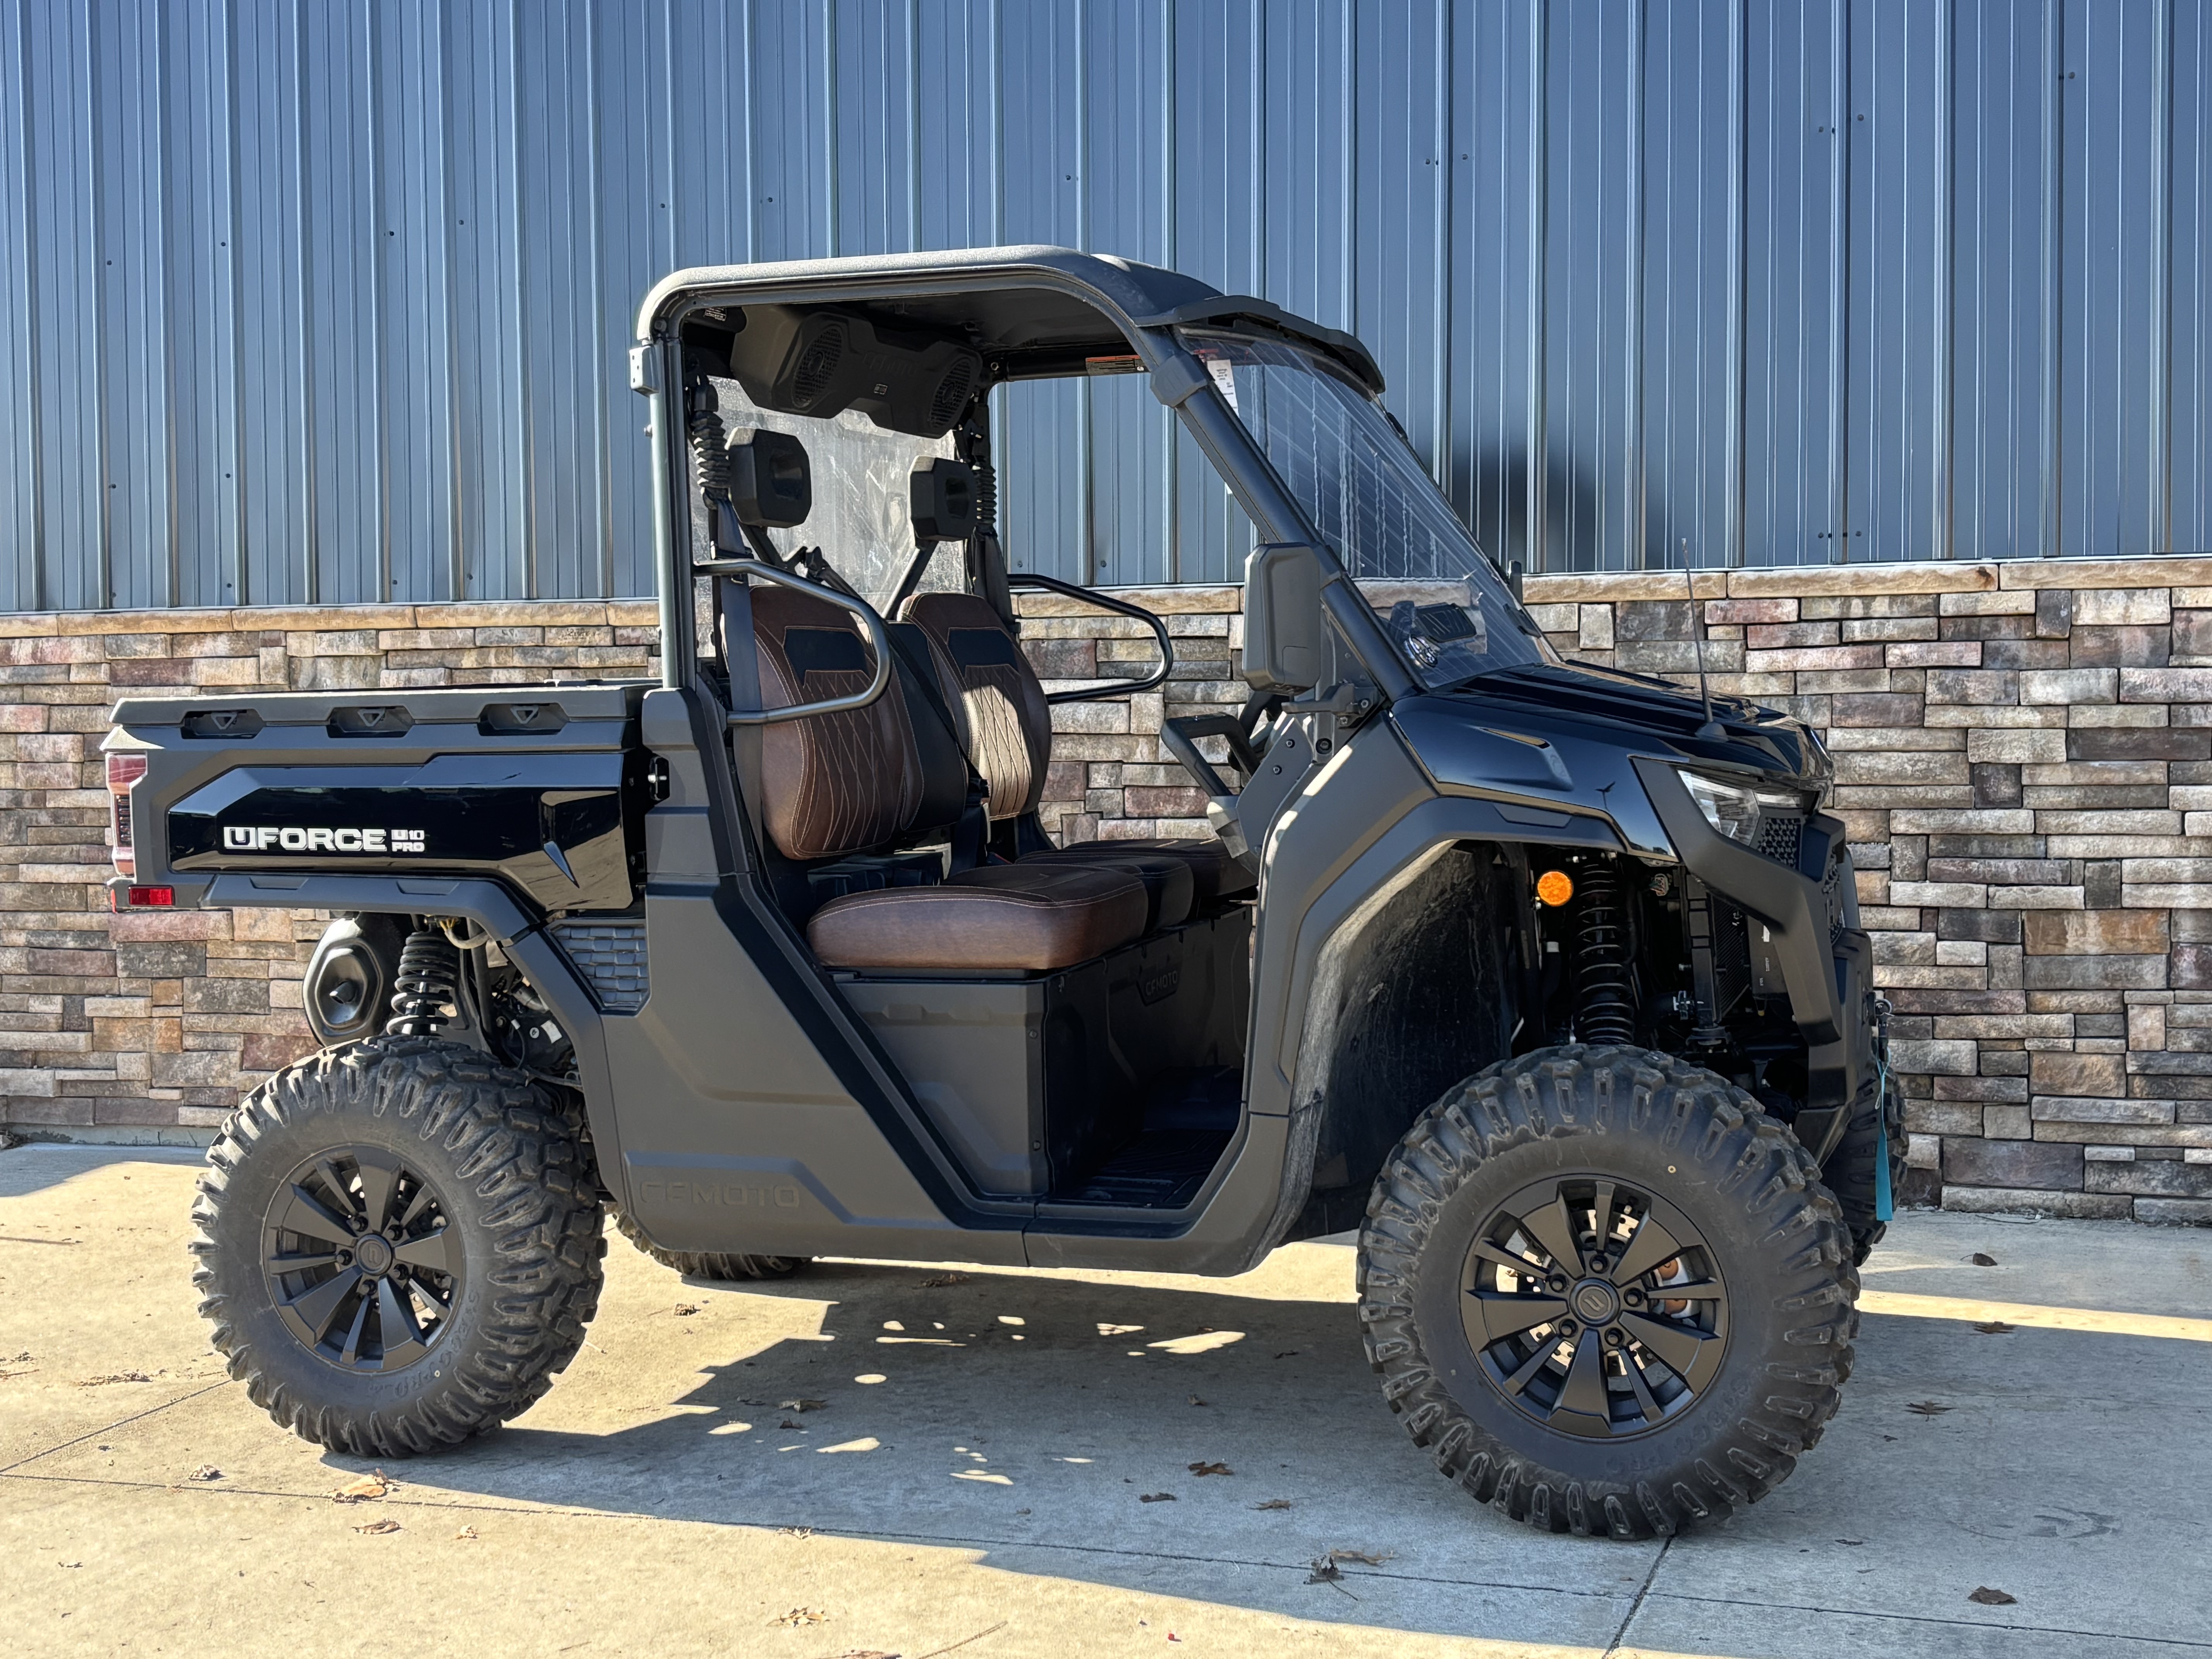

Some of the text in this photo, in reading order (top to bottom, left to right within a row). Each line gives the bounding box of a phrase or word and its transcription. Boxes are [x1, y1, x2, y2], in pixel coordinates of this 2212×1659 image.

[223, 826, 387, 851] UFORCE
[391, 829, 425, 840] U10
[392, 842, 425, 852] PRO
[1146, 970, 1178, 996] CFMOTO
[640, 1181, 800, 1208] CFMOTO
